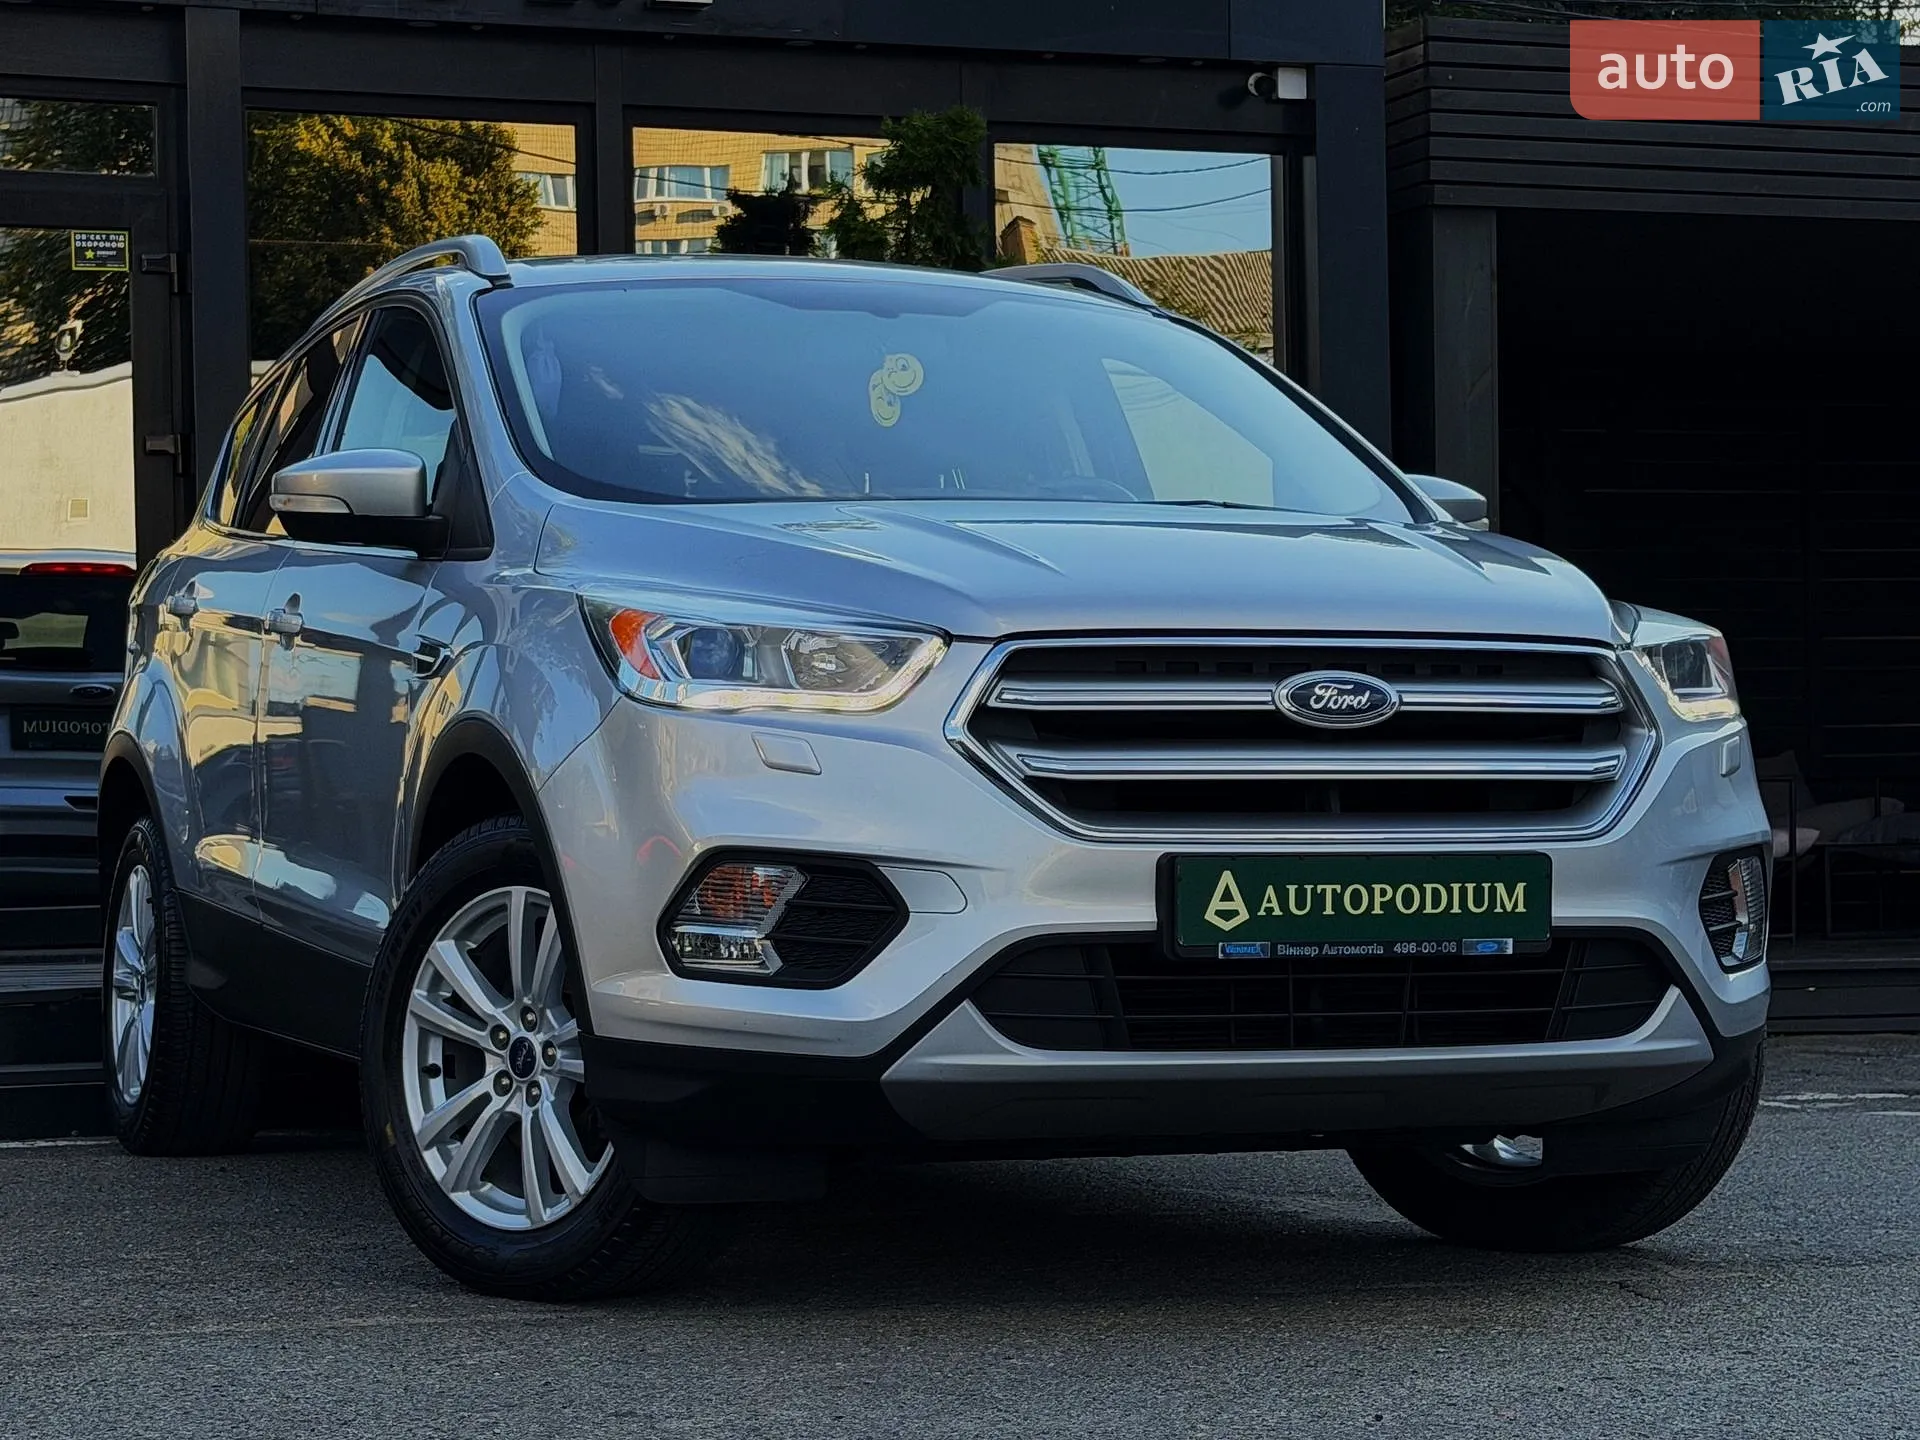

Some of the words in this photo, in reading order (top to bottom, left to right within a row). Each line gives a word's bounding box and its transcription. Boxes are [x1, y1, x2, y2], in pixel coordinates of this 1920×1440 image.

[1309, 682, 1371, 710] Ford
[1257, 882, 1527, 916] AUTOPODIUM
[1322, 943, 1385, 955] Автомотів
[1393, 941, 1457, 954] 496-00-06
